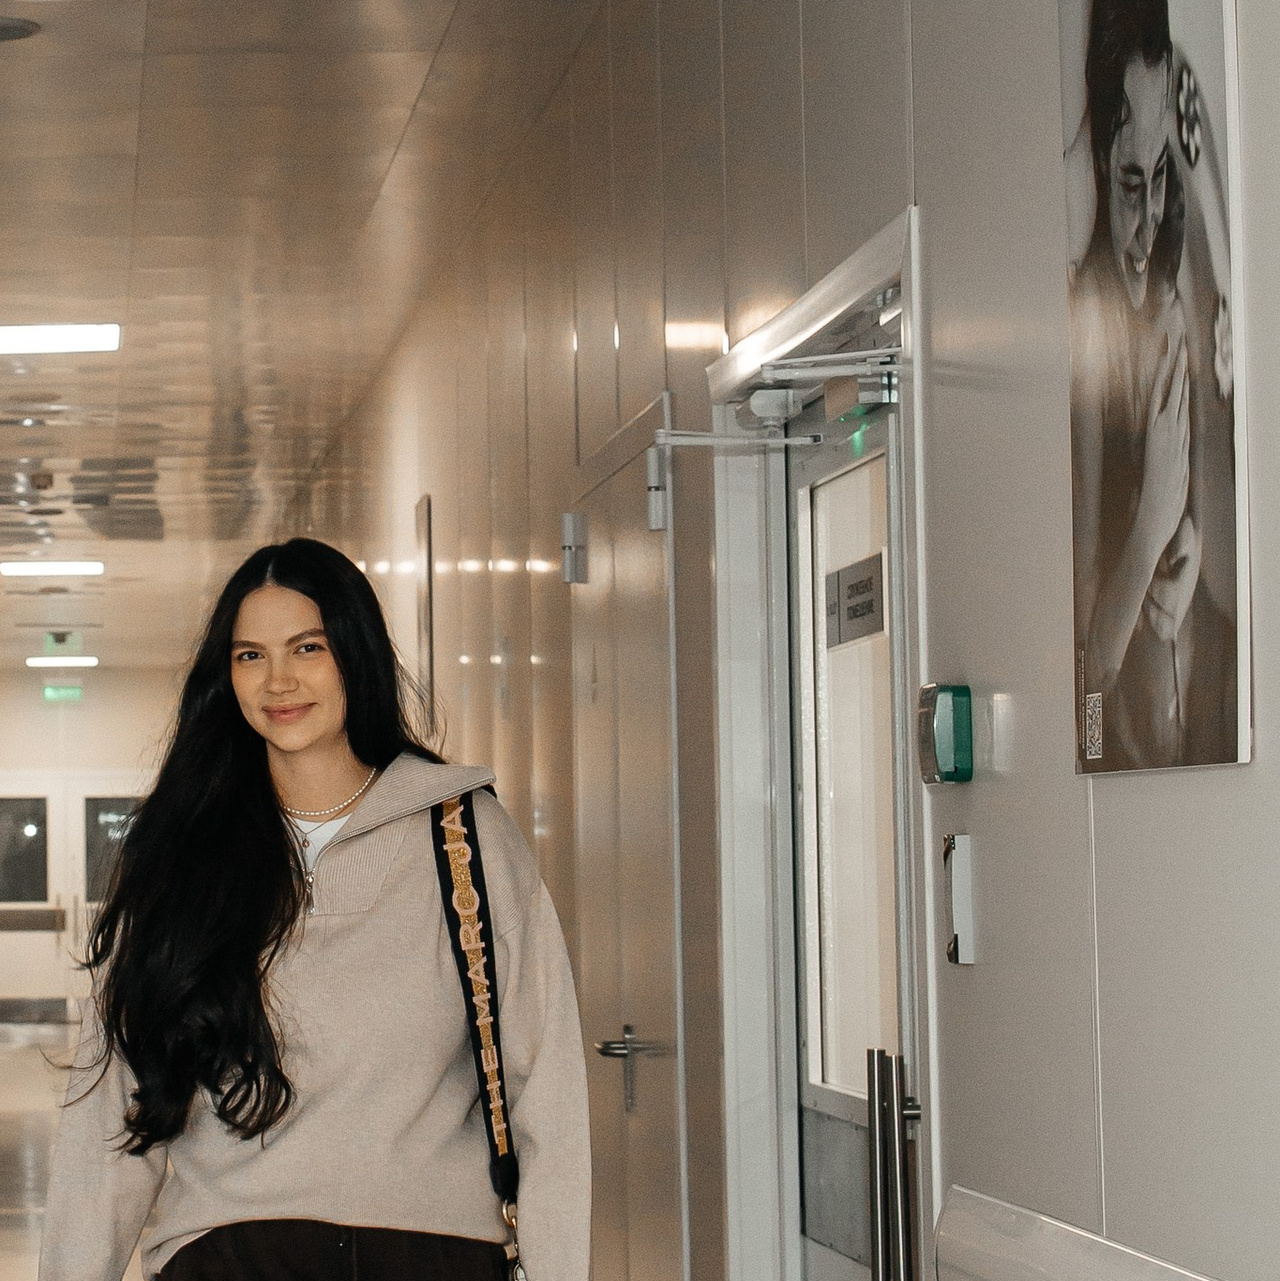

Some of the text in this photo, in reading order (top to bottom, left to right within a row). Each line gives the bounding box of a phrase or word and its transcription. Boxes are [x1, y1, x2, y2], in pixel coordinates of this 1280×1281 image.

[440, 795, 507, 1144] THE MARC JA
